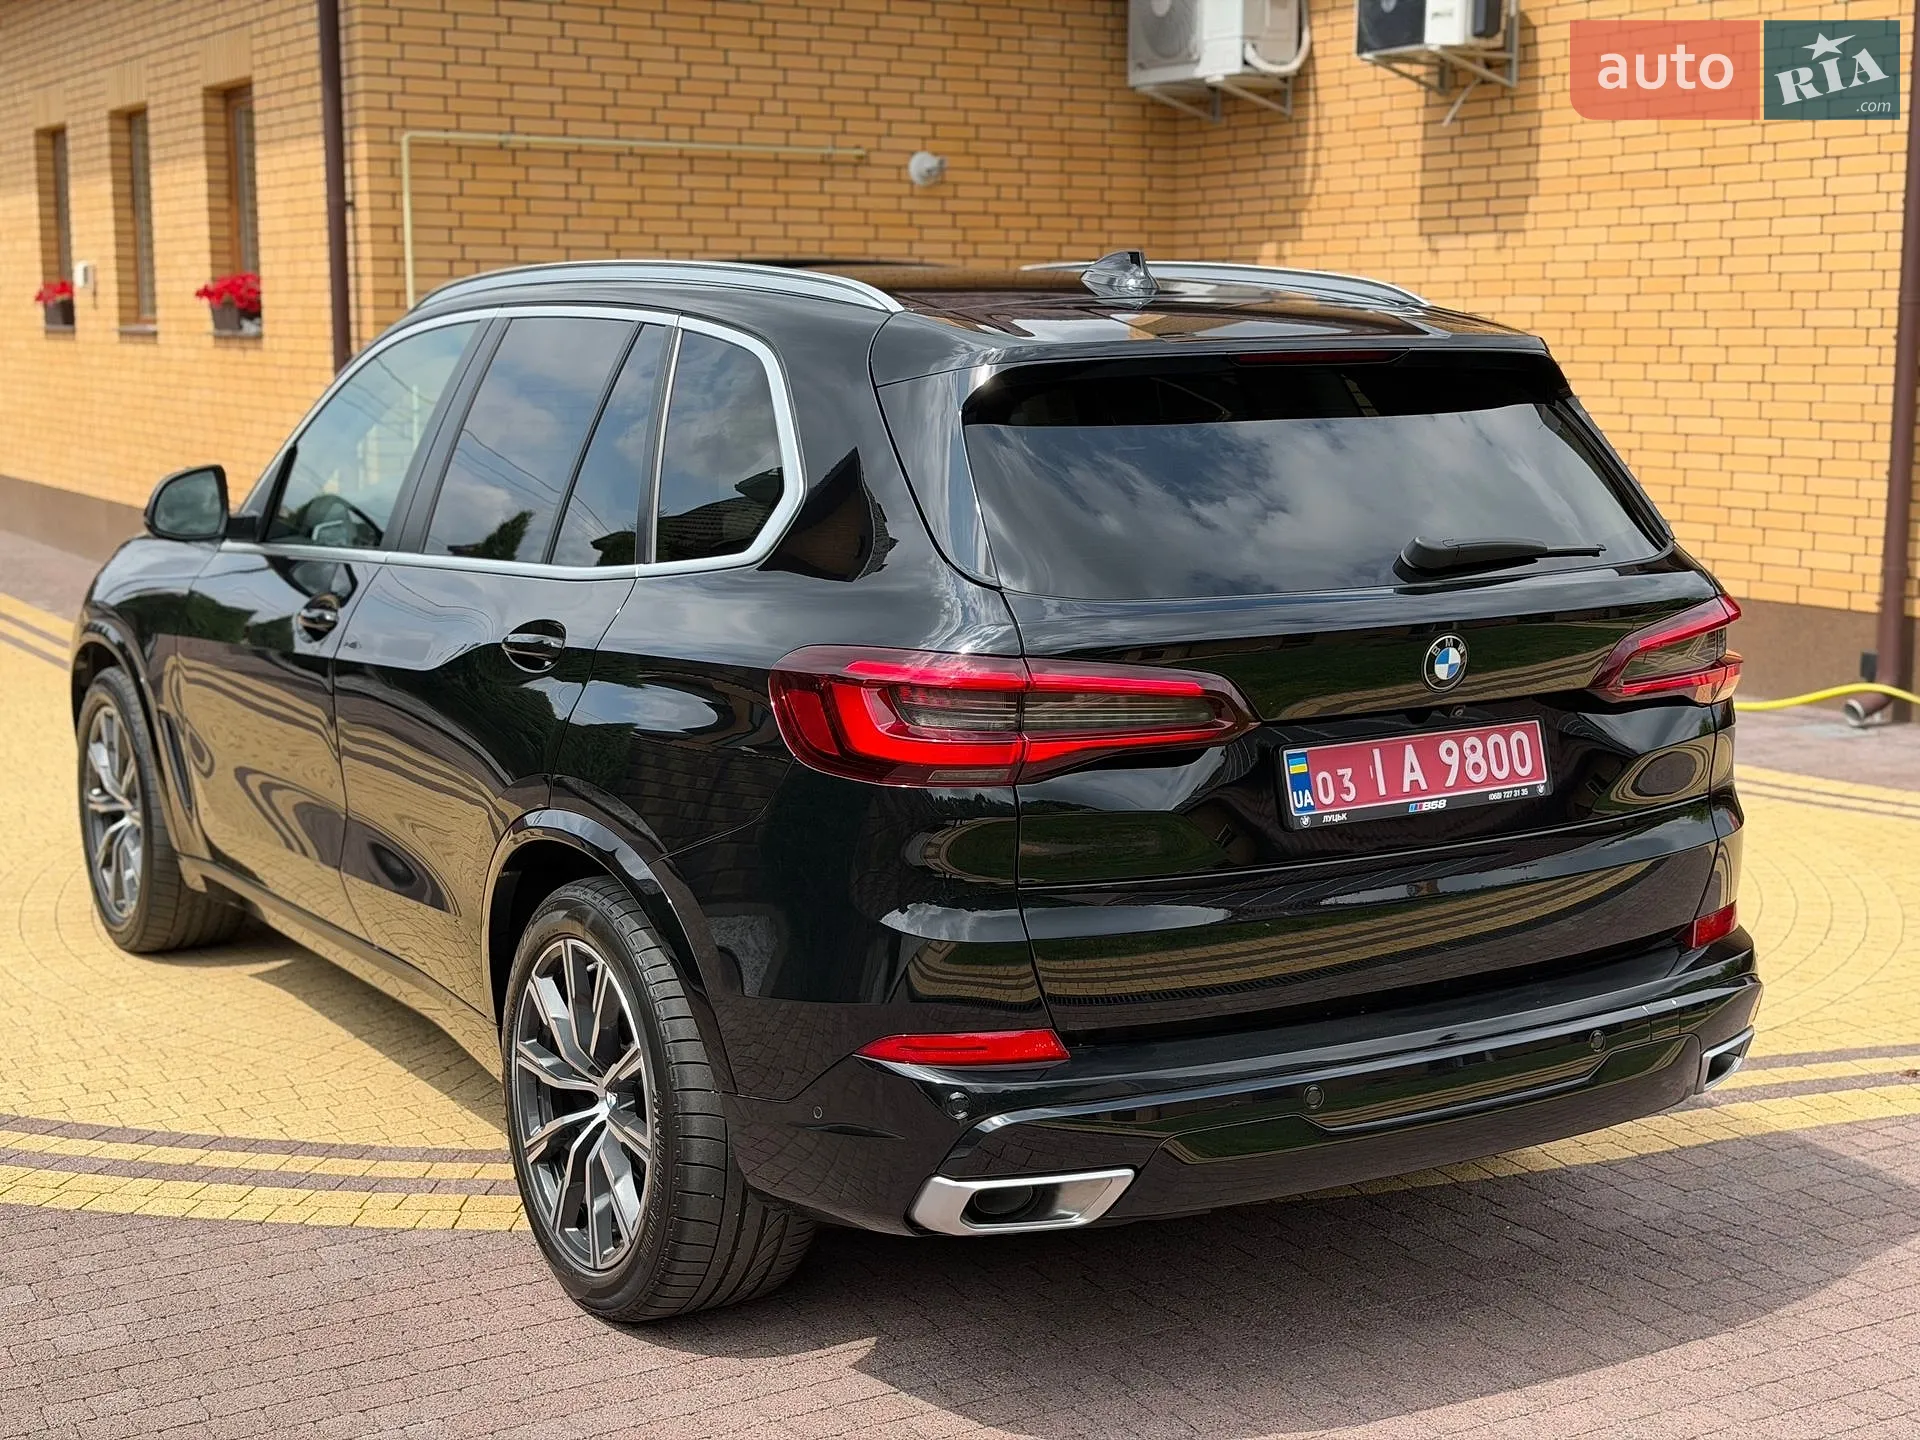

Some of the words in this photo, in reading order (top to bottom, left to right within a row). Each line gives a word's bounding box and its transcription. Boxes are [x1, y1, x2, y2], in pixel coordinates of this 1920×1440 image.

[1431, 638, 1465, 656] BMW
[1316, 767, 1357, 805] 03
[1438, 730, 1533, 787] 9800
[1294, 790, 1315, 808] UA
[1322, 812, 1347, 823] ЛУЦЬК
